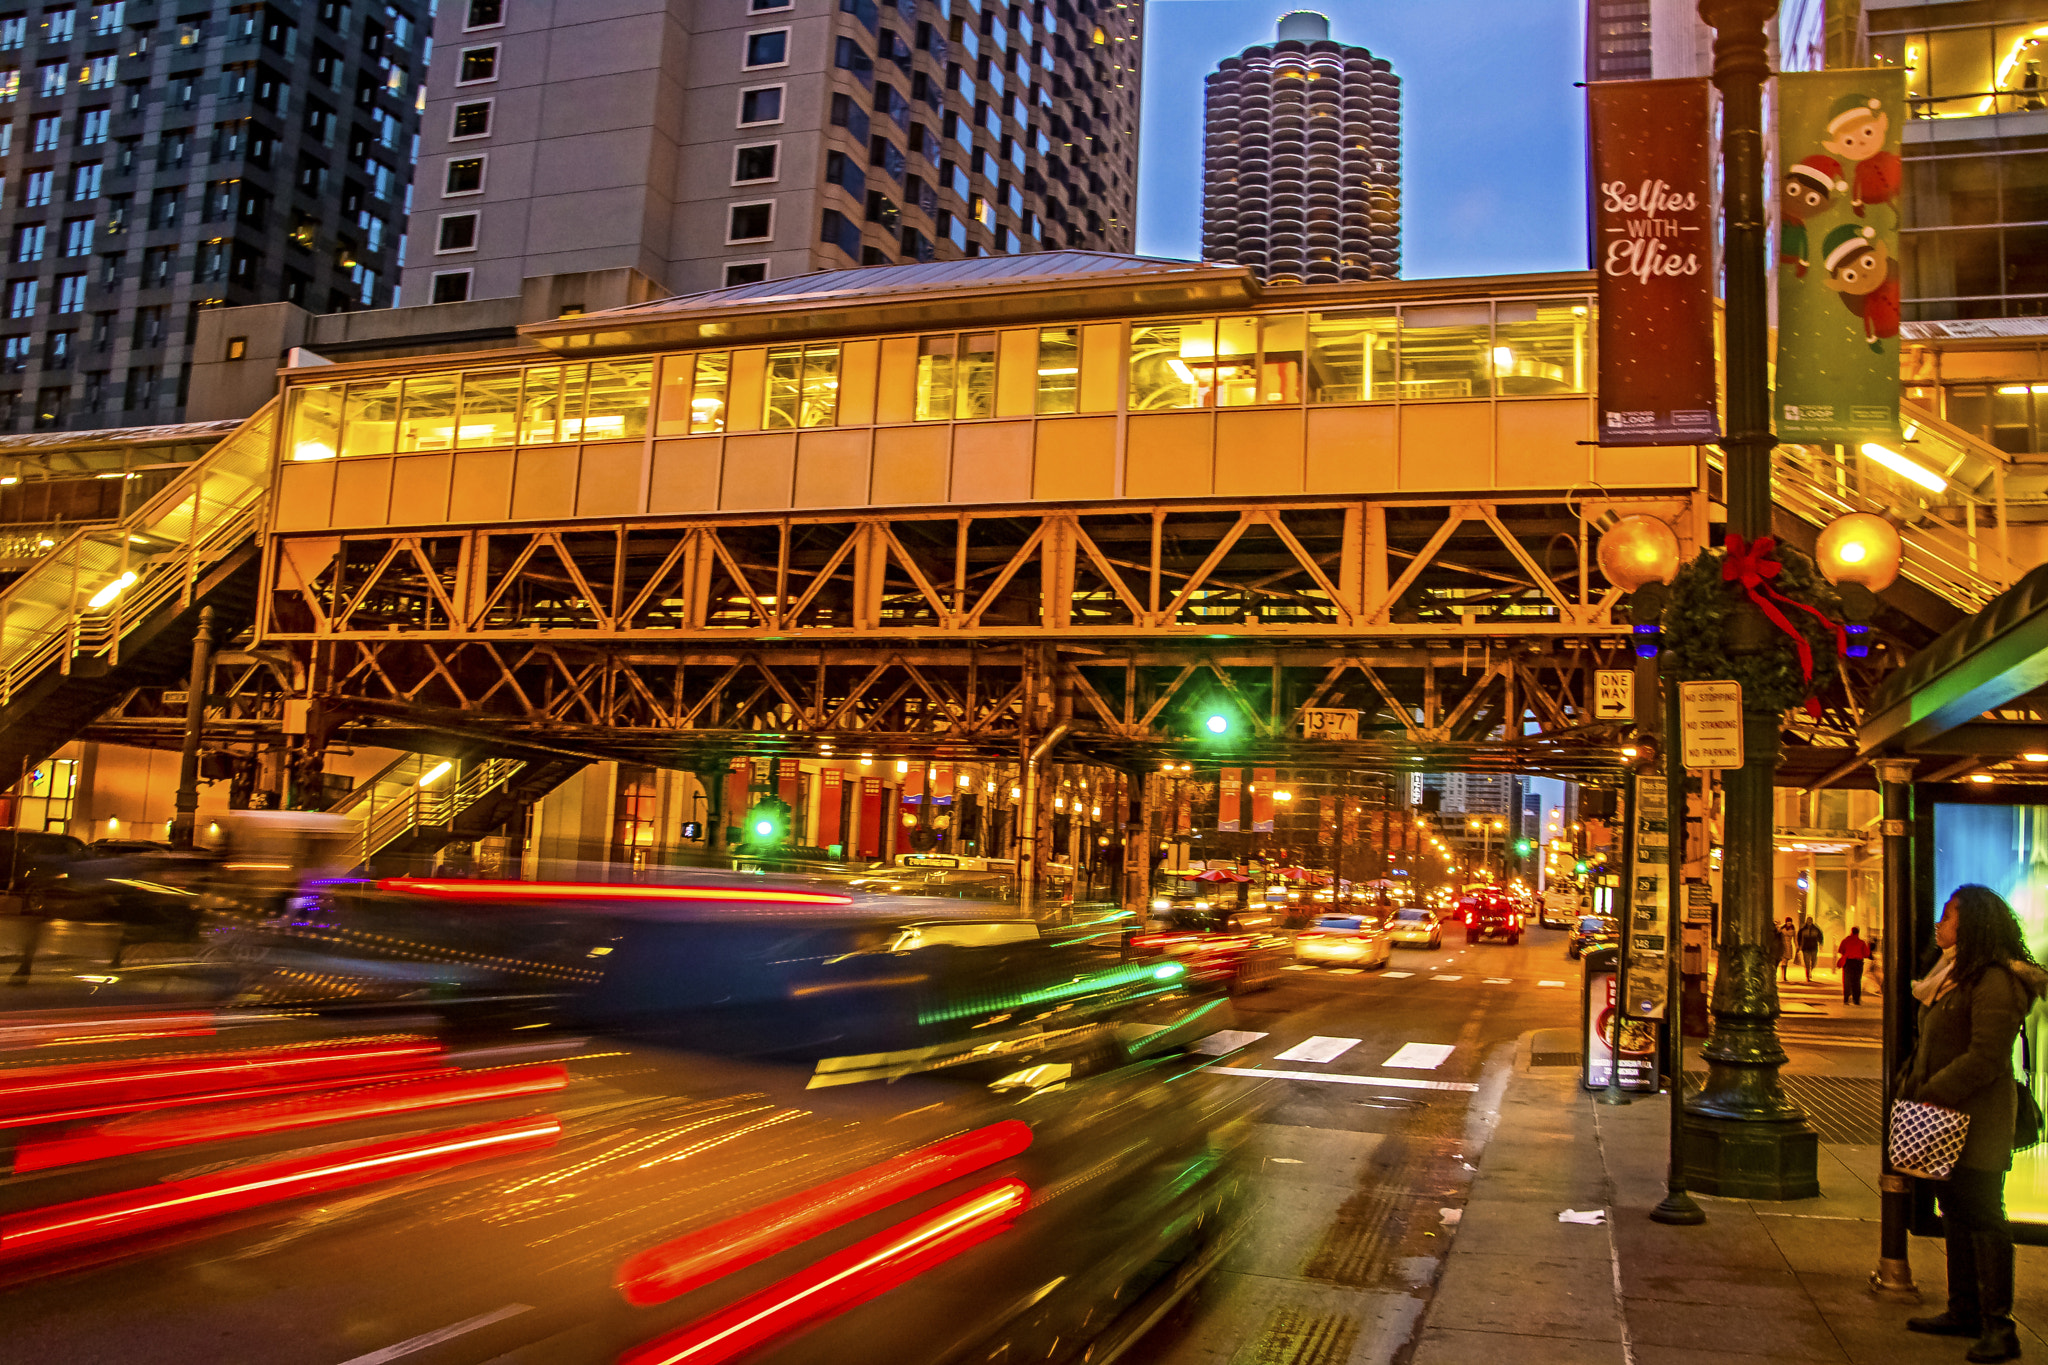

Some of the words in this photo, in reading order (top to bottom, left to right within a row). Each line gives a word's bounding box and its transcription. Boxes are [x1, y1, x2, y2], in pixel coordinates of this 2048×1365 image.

[1601, 179, 1699, 218] Selfies
[1626, 219, 1678, 238] WITH
[1604, 238, 1702, 285] Elfies
[1621, 415, 1655, 424] LOOP
[1601, 675, 1628, 686] ONE
[1601, 688, 1629, 699] WAY
[1685, 693, 1696, 702] NO
[1698, 692, 1737, 702] STOPPING
[1686, 721, 1698, 730] NO
[1700, 720, 1738, 730] STANDING
[1688, 748, 1700, 757] NO
[1702, 747, 1737, 757] PARKING
[1643, 821, 1650, 831] 2
